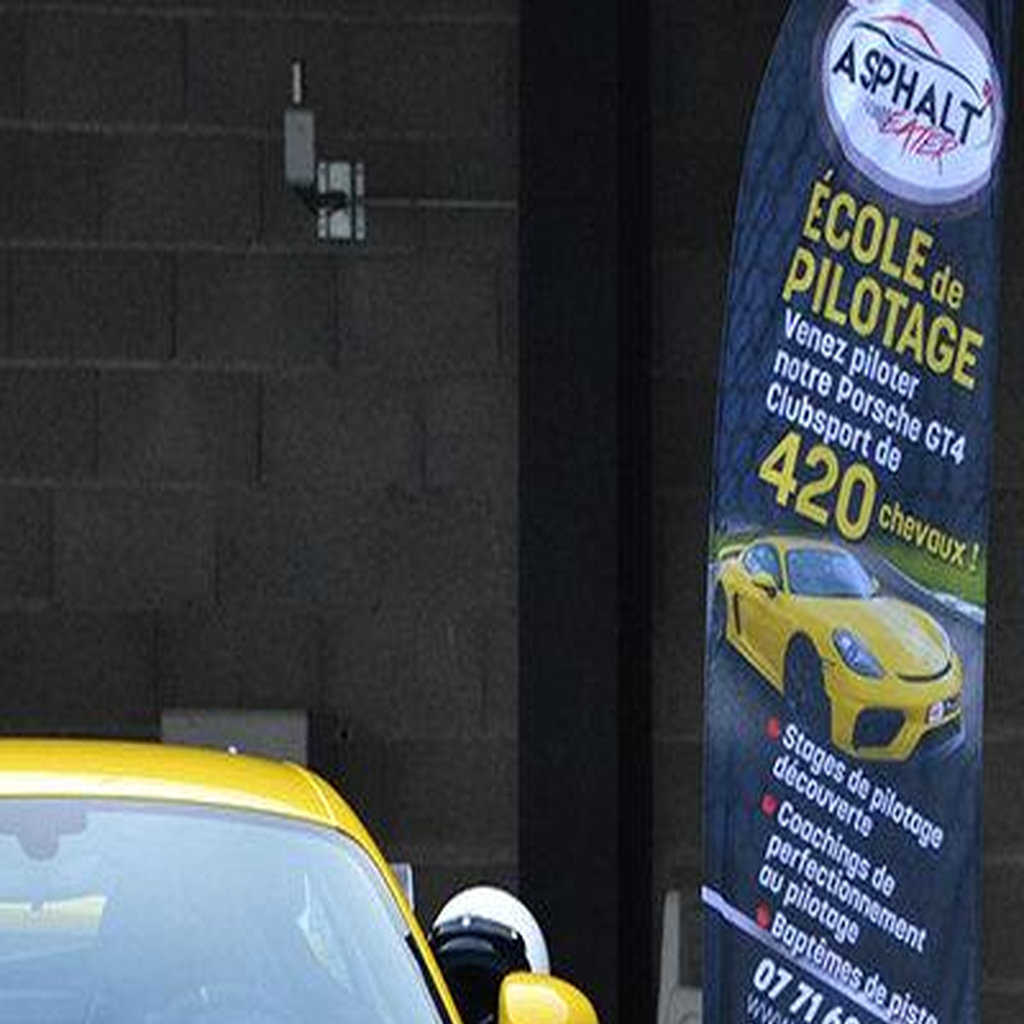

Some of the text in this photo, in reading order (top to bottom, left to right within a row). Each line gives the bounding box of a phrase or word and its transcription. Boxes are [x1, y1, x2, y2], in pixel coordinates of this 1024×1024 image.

[832, 41, 986, 146] ASPHALT
[803, 169, 964, 308] ÉCOLE de
[782, 247, 984, 390] PILOTAGE
[784, 309, 919, 400] Venez piloter
[766, 382, 902, 472] Clubsport de
[774, 350, 966, 465] notre Porsche GT4
[758, 432, 877, 541] 420
[879, 502, 967, 569] chevaux
[782, 723, 944, 849] Stages de pilotage
[765, 835, 927, 953] perfectionnement
[777, 801, 895, 897] Coachings de
[759, 865, 860, 945] au pilotage
[753, 958, 792, 999] 07
[789, 981, 823, 1022] 71
[771, 913, 862, 991] Baptêmes
[864, 974, 887, 1006] de
